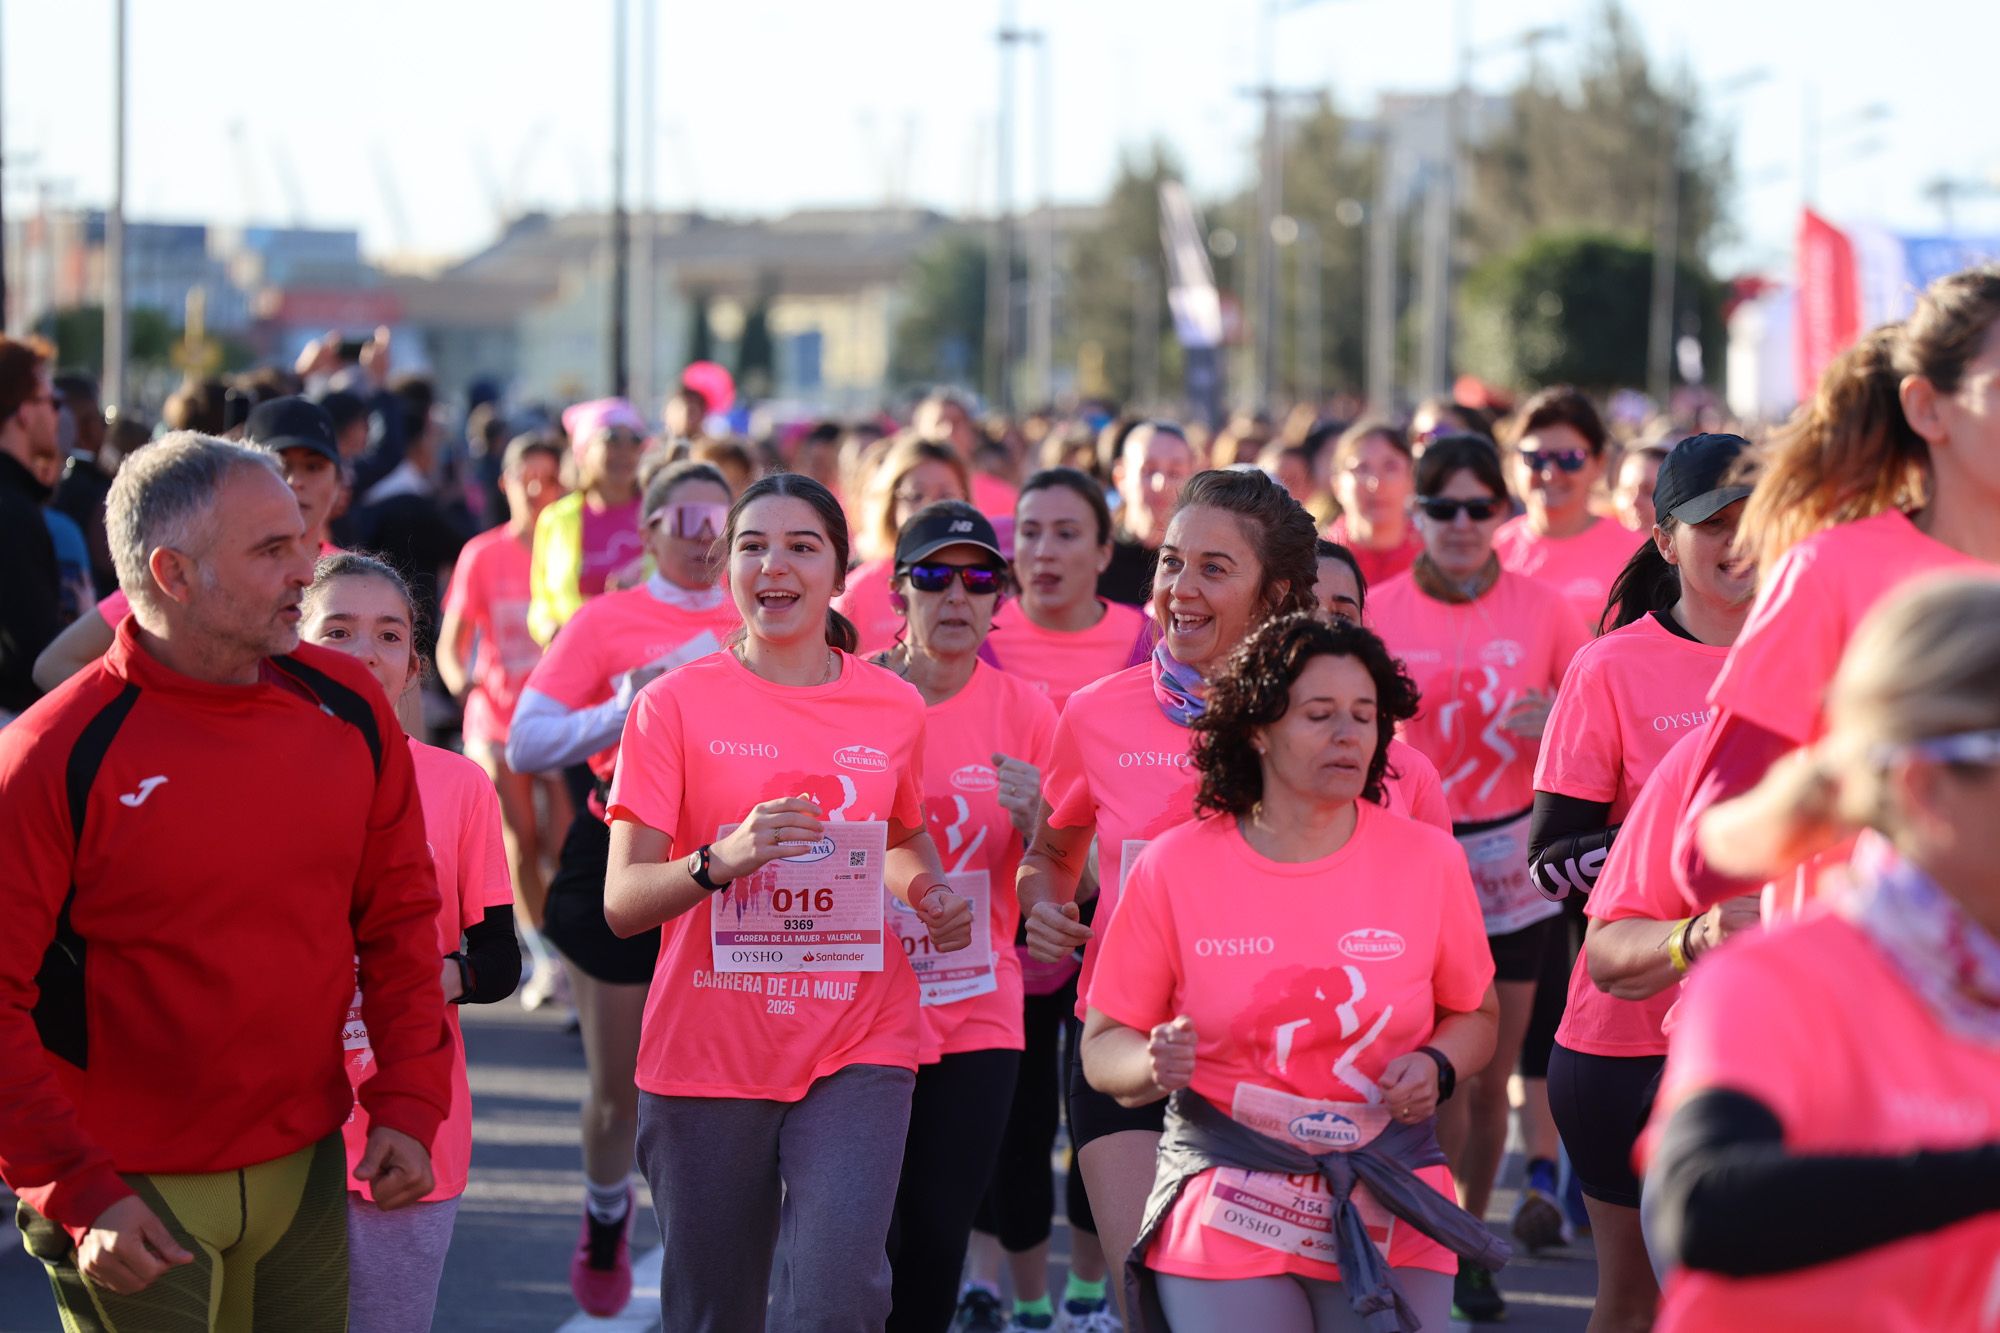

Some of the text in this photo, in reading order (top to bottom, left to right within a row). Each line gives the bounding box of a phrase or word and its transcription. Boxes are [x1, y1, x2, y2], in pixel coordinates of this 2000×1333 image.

[948, 520, 974, 532] NB
[709, 740, 778, 759] OYSHO
[839, 752, 887, 767] ASTURIANA
[1118, 751, 1190, 768] OYSHO
[772, 888, 833, 912] 016
[784, 919, 813, 930] 9369
[734, 932, 862, 943] CARRERA DE LA MUJER VALENCIA
[901, 936, 930, 956] 01
[1195, 936, 1274, 957] OYSHO
[732, 951, 865, 963] OYSHO Santander
[693, 969, 858, 1001] CARRERA DE LA MUJE
[766, 999, 796, 1015] 2025
[1295, 1122, 1356, 1142] ASTURIANA
[1233, 1192, 1272, 1213] CARRERA
[1272, 1205, 1286, 1219] DE
[1286, 1209, 1298, 1223] LA
[1291, 1197, 1323, 1215] 7154
[1224, 1208, 1282, 1238] OYSHO
